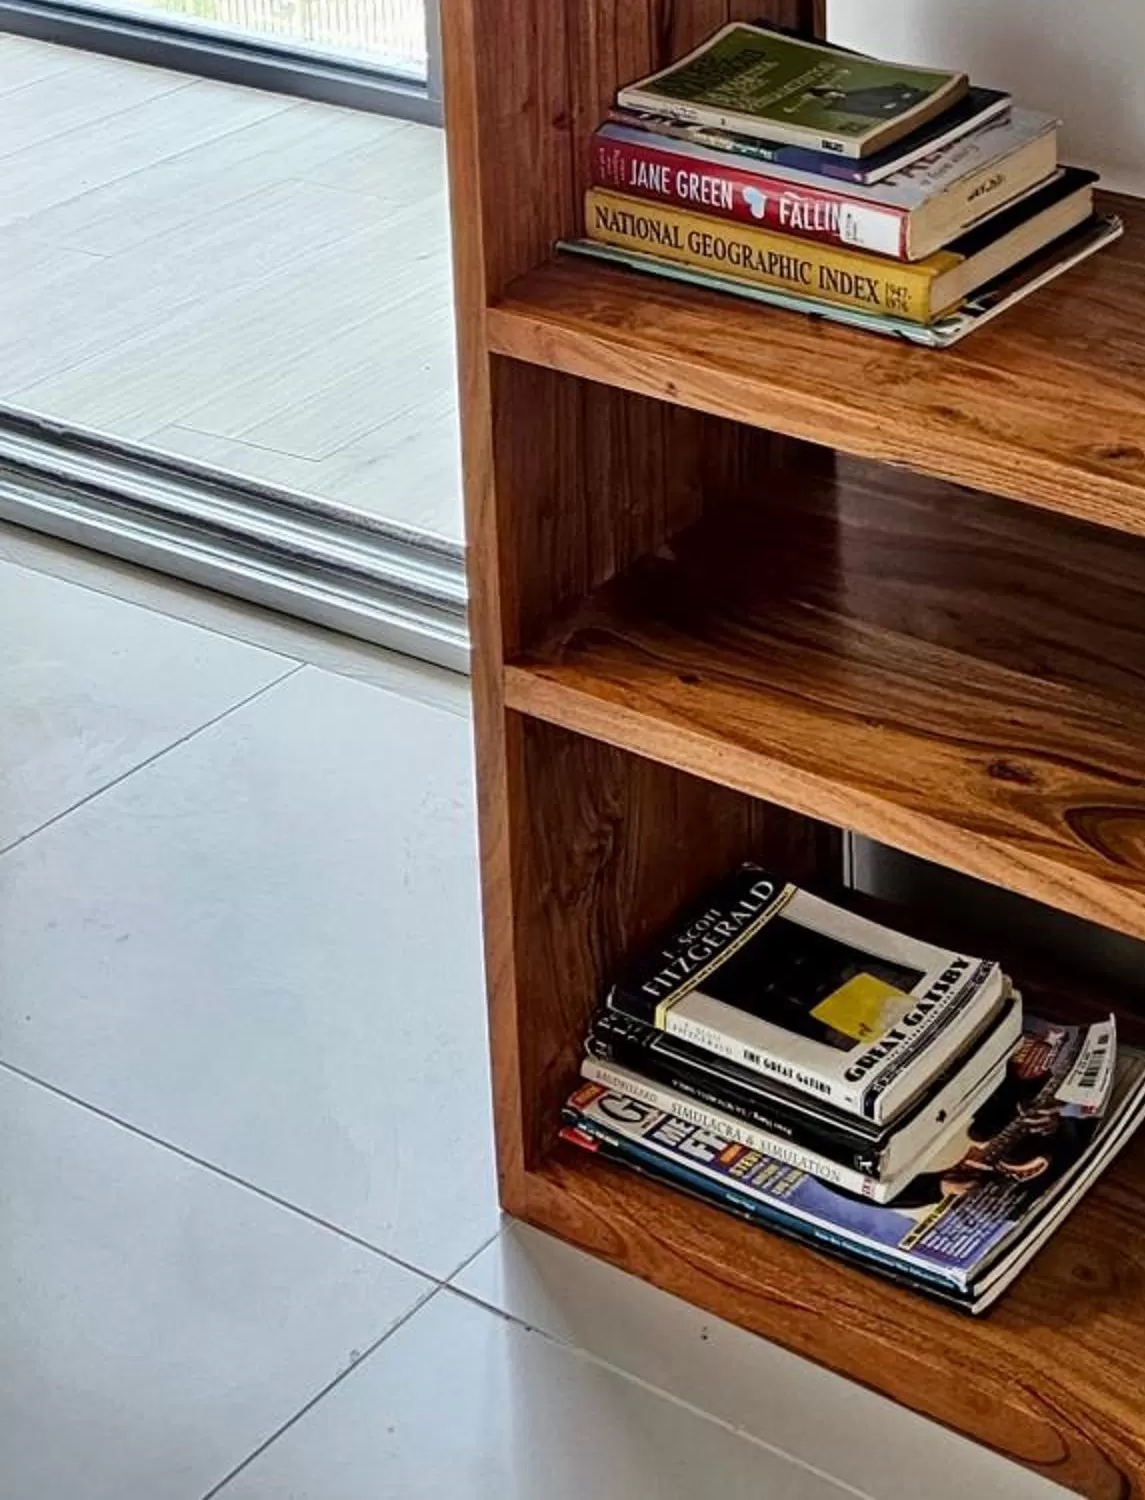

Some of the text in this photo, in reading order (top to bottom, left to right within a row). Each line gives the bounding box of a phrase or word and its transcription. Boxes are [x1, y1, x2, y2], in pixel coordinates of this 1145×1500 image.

[629, 158, 671, 197] JANE
[676, 169, 733, 210] GREEN
[779, 195, 841, 232] FALLIN
[594, 205, 685, 250] NATIONAL
[687, 231, 815, 286] GEOGRAPHIC
[818, 265, 881, 305] INDEX
[641, 879, 775, 997] FITZGERALD
[677, 908, 722, 944] SCOTT
[844, 1028, 907, 1083] GREAT
[902, 956, 970, 1027] GATSBY
[743, 1048, 832, 1096] THE GREAT GATSBY
[671, 1101, 742, 1140] SIMULACRA
[760, 1139, 843, 1182] SIMULATION
